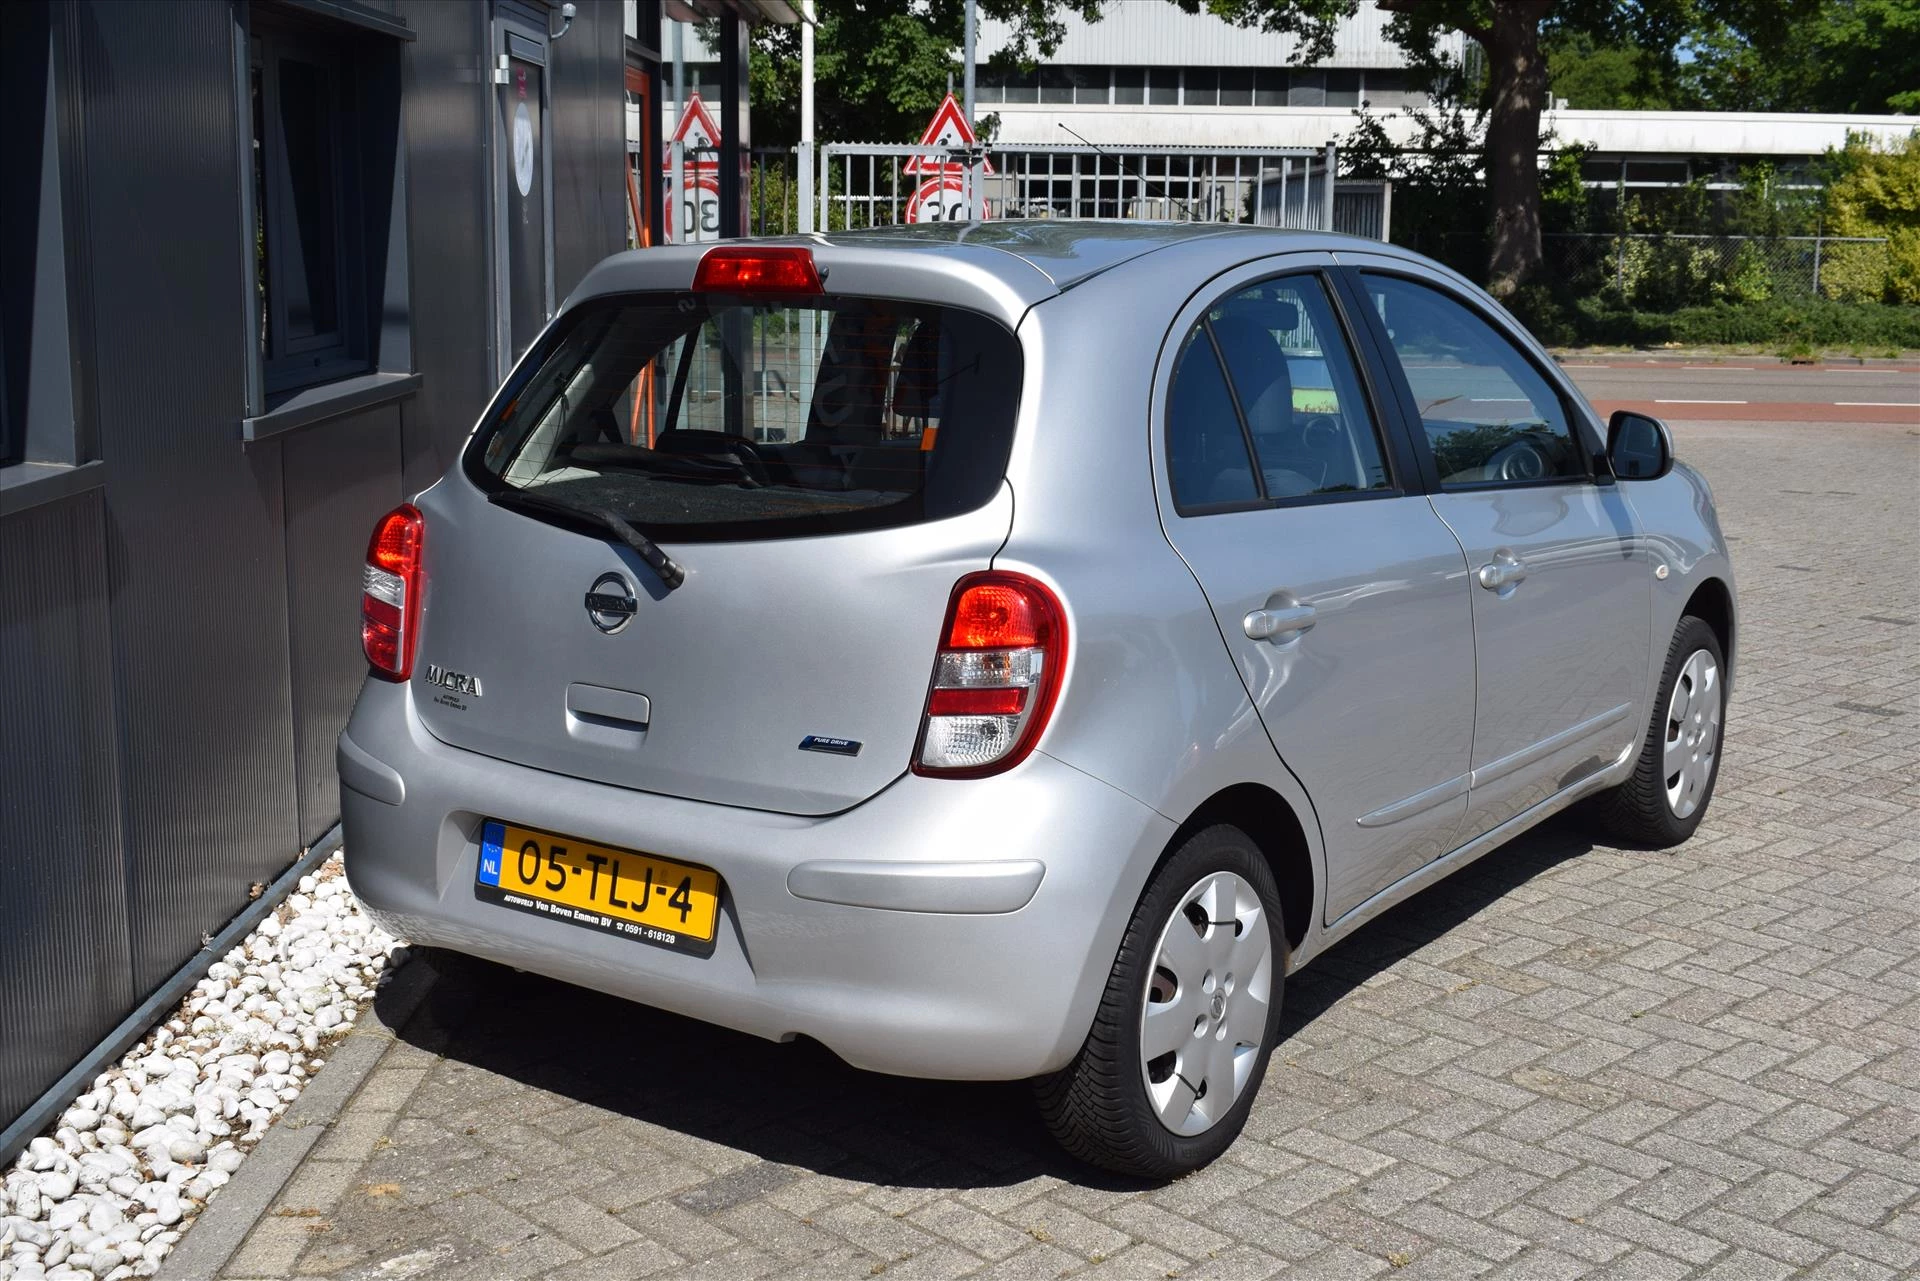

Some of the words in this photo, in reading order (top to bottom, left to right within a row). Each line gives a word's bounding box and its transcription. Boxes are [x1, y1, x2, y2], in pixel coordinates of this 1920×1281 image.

[425, 664, 482, 697] MICRA
[483, 859, 498, 875] NL
[518, 840, 692, 923] 05-TLJ-4
[535, 900, 549, 912] Van
[550, 904, 572, 917] Boven
[573, 910, 599, 924] Emmen
[600, 916, 612, 928] BV
[624, 923, 642, 935] 0591
[648, 929, 676, 944] 618128
